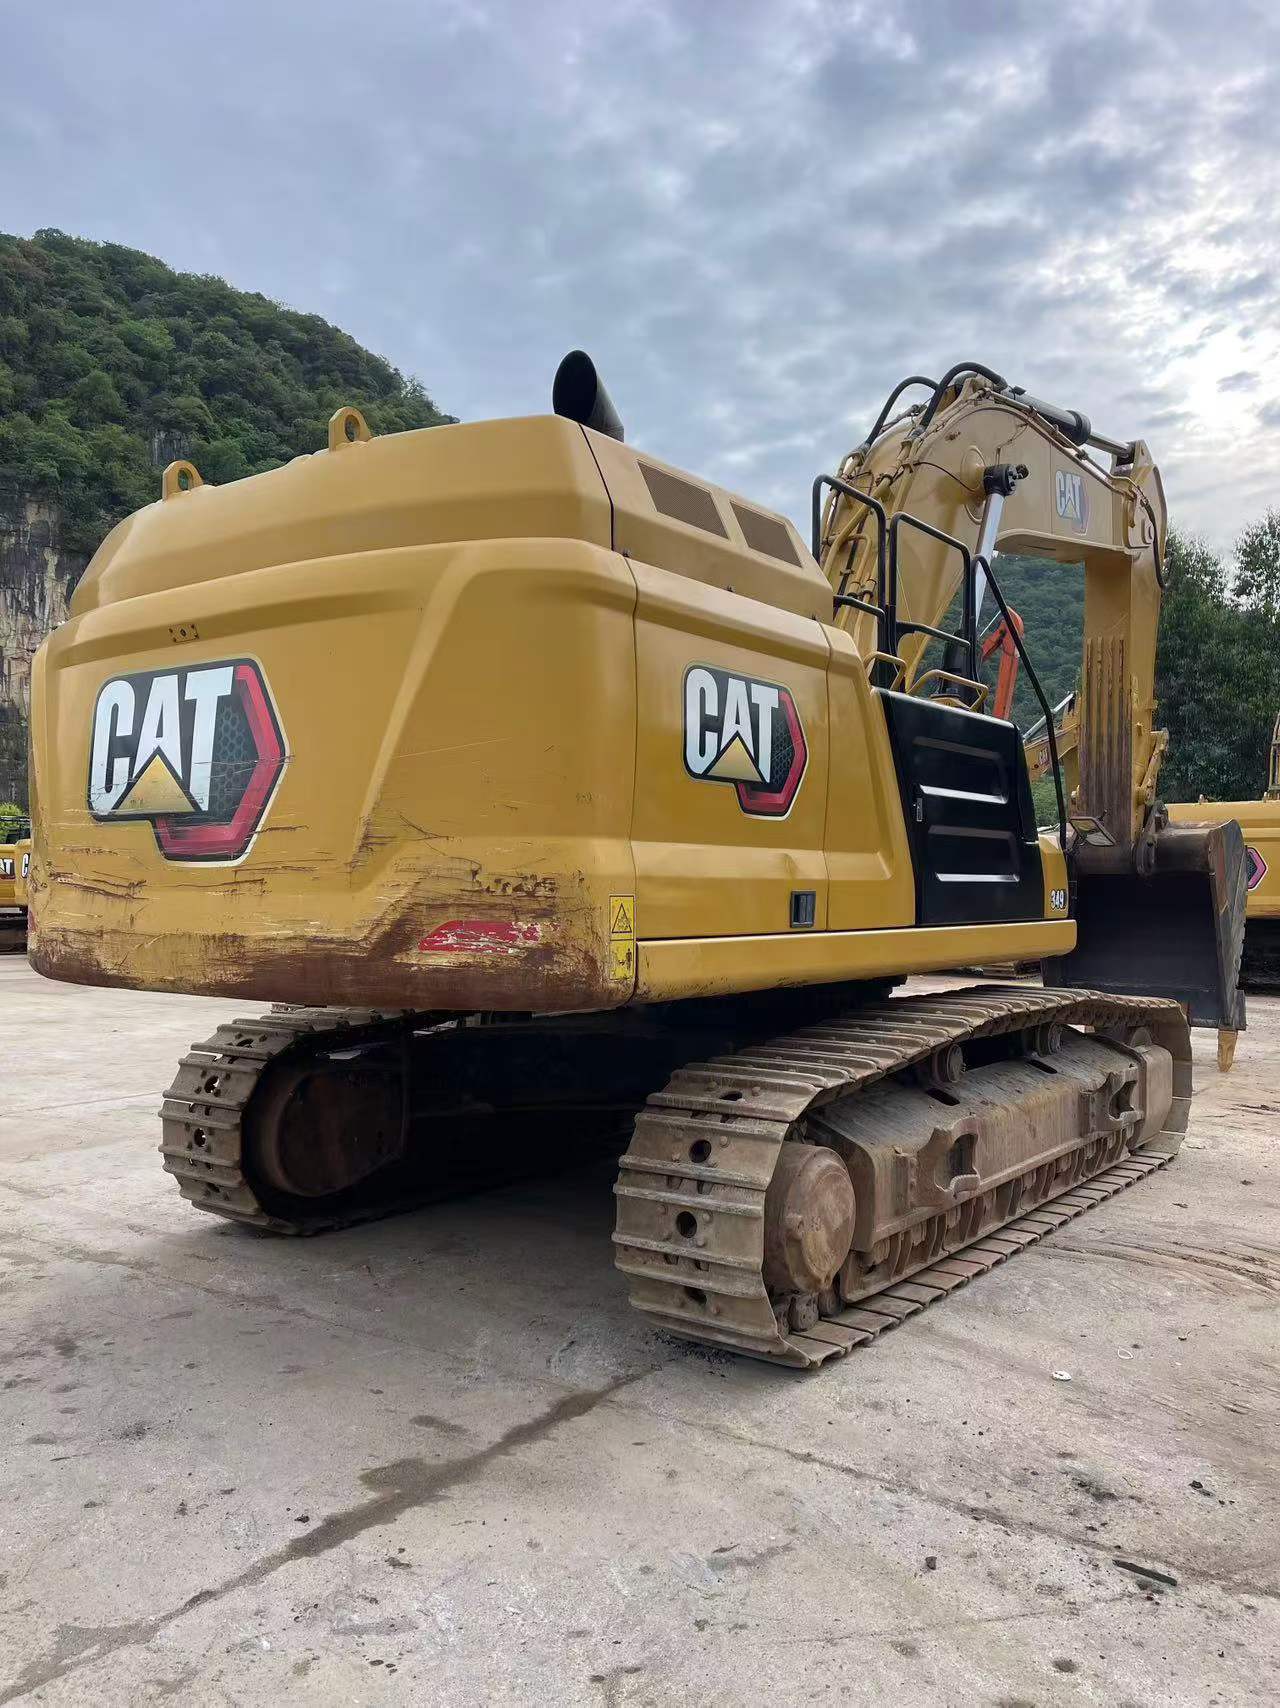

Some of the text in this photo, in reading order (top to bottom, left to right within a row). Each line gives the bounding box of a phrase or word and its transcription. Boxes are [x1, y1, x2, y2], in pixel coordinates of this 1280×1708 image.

[1056, 470, 1081, 519] CAT
[91, 666, 234, 815] CAT
[686, 668, 779, 783] CAT
